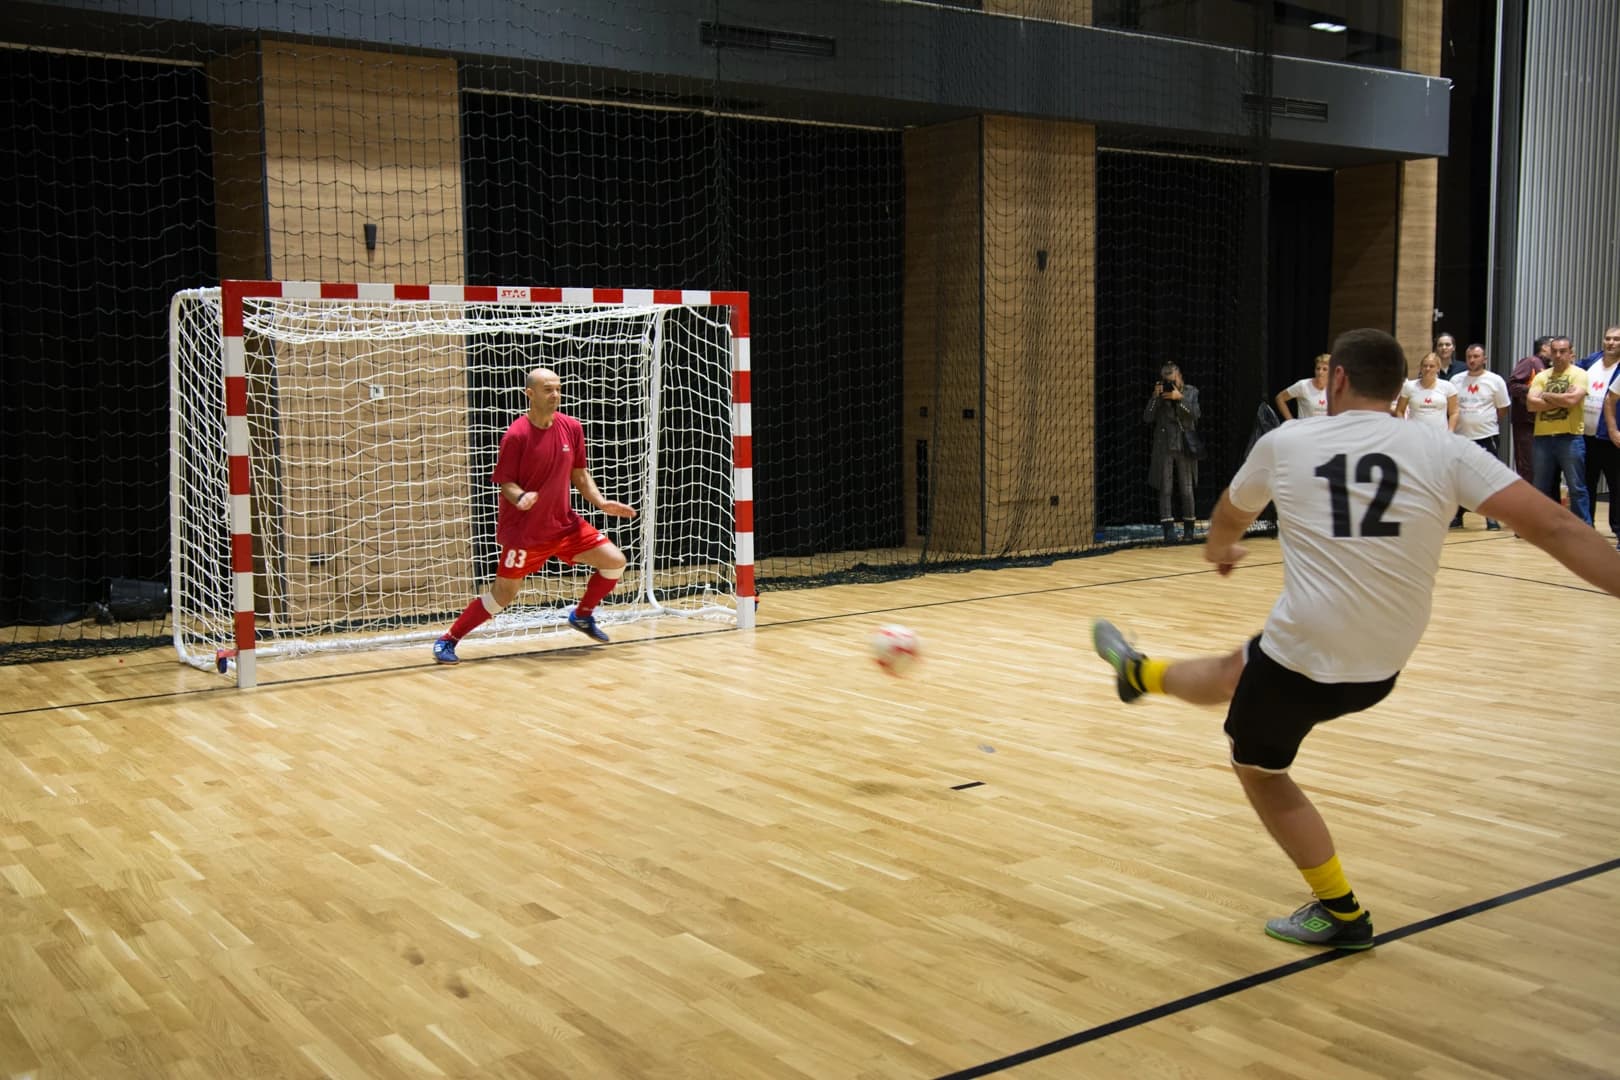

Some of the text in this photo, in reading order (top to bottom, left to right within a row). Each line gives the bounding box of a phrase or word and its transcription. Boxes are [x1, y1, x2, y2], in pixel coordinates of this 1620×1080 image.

[501, 289, 526, 298] STAG
[1314, 452, 1401, 537] 12
[504, 549, 527, 568] 83
